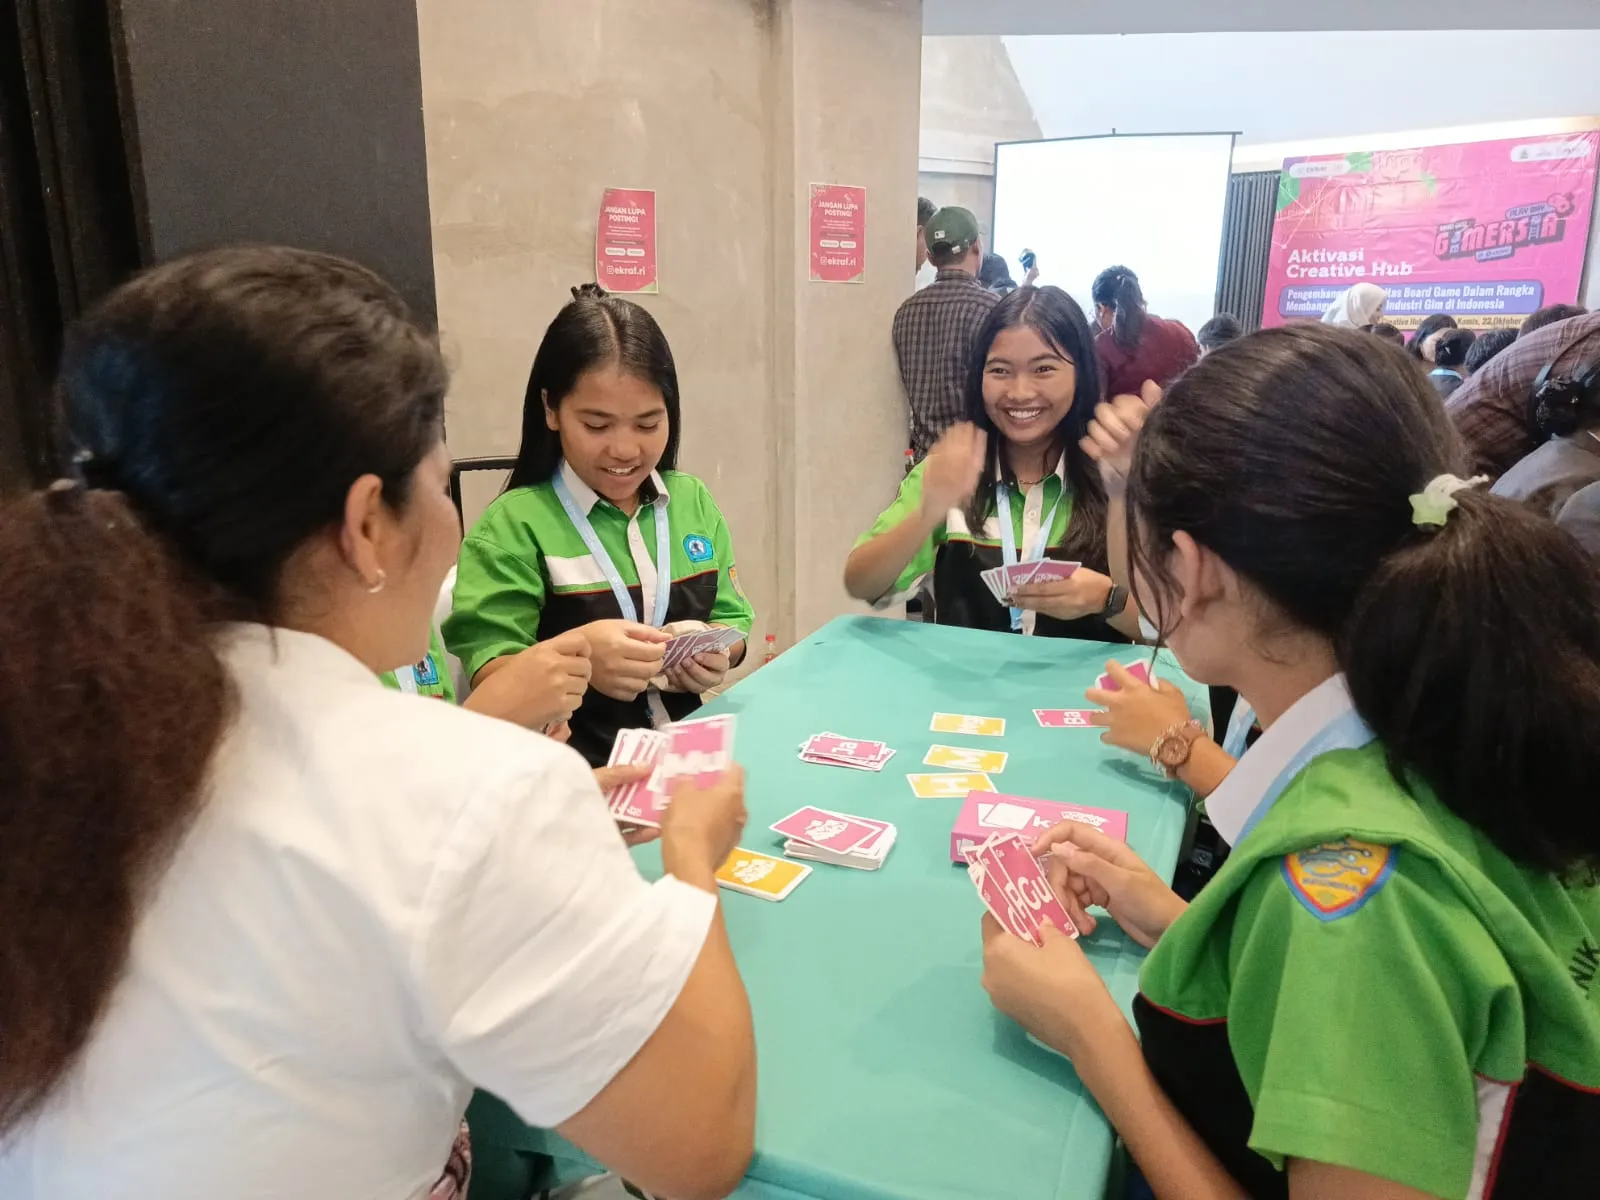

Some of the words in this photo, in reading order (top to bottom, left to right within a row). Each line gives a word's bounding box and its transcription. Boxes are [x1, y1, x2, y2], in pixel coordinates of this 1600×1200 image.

[628, 207, 646, 216] LUPA
[1287, 247, 1364, 263] Aktivasi
[1286, 263, 1366, 278] Creative
[1371, 259, 1414, 277] Hub
[1403, 286, 1432, 298] Board
[1433, 286, 1461, 298] Game
[1463, 285, 1494, 297] Dalam
[1496, 284, 1535, 298] Rangka
[1386, 300, 1423, 311] Industri
[1424, 299, 1443, 310] Gim
[1445, 299, 1455, 310] di
[1456, 299, 1505, 310] Indonesia
[1063, 711, 1087, 725] Ba
[1568, 936, 1600, 1000] NIK
